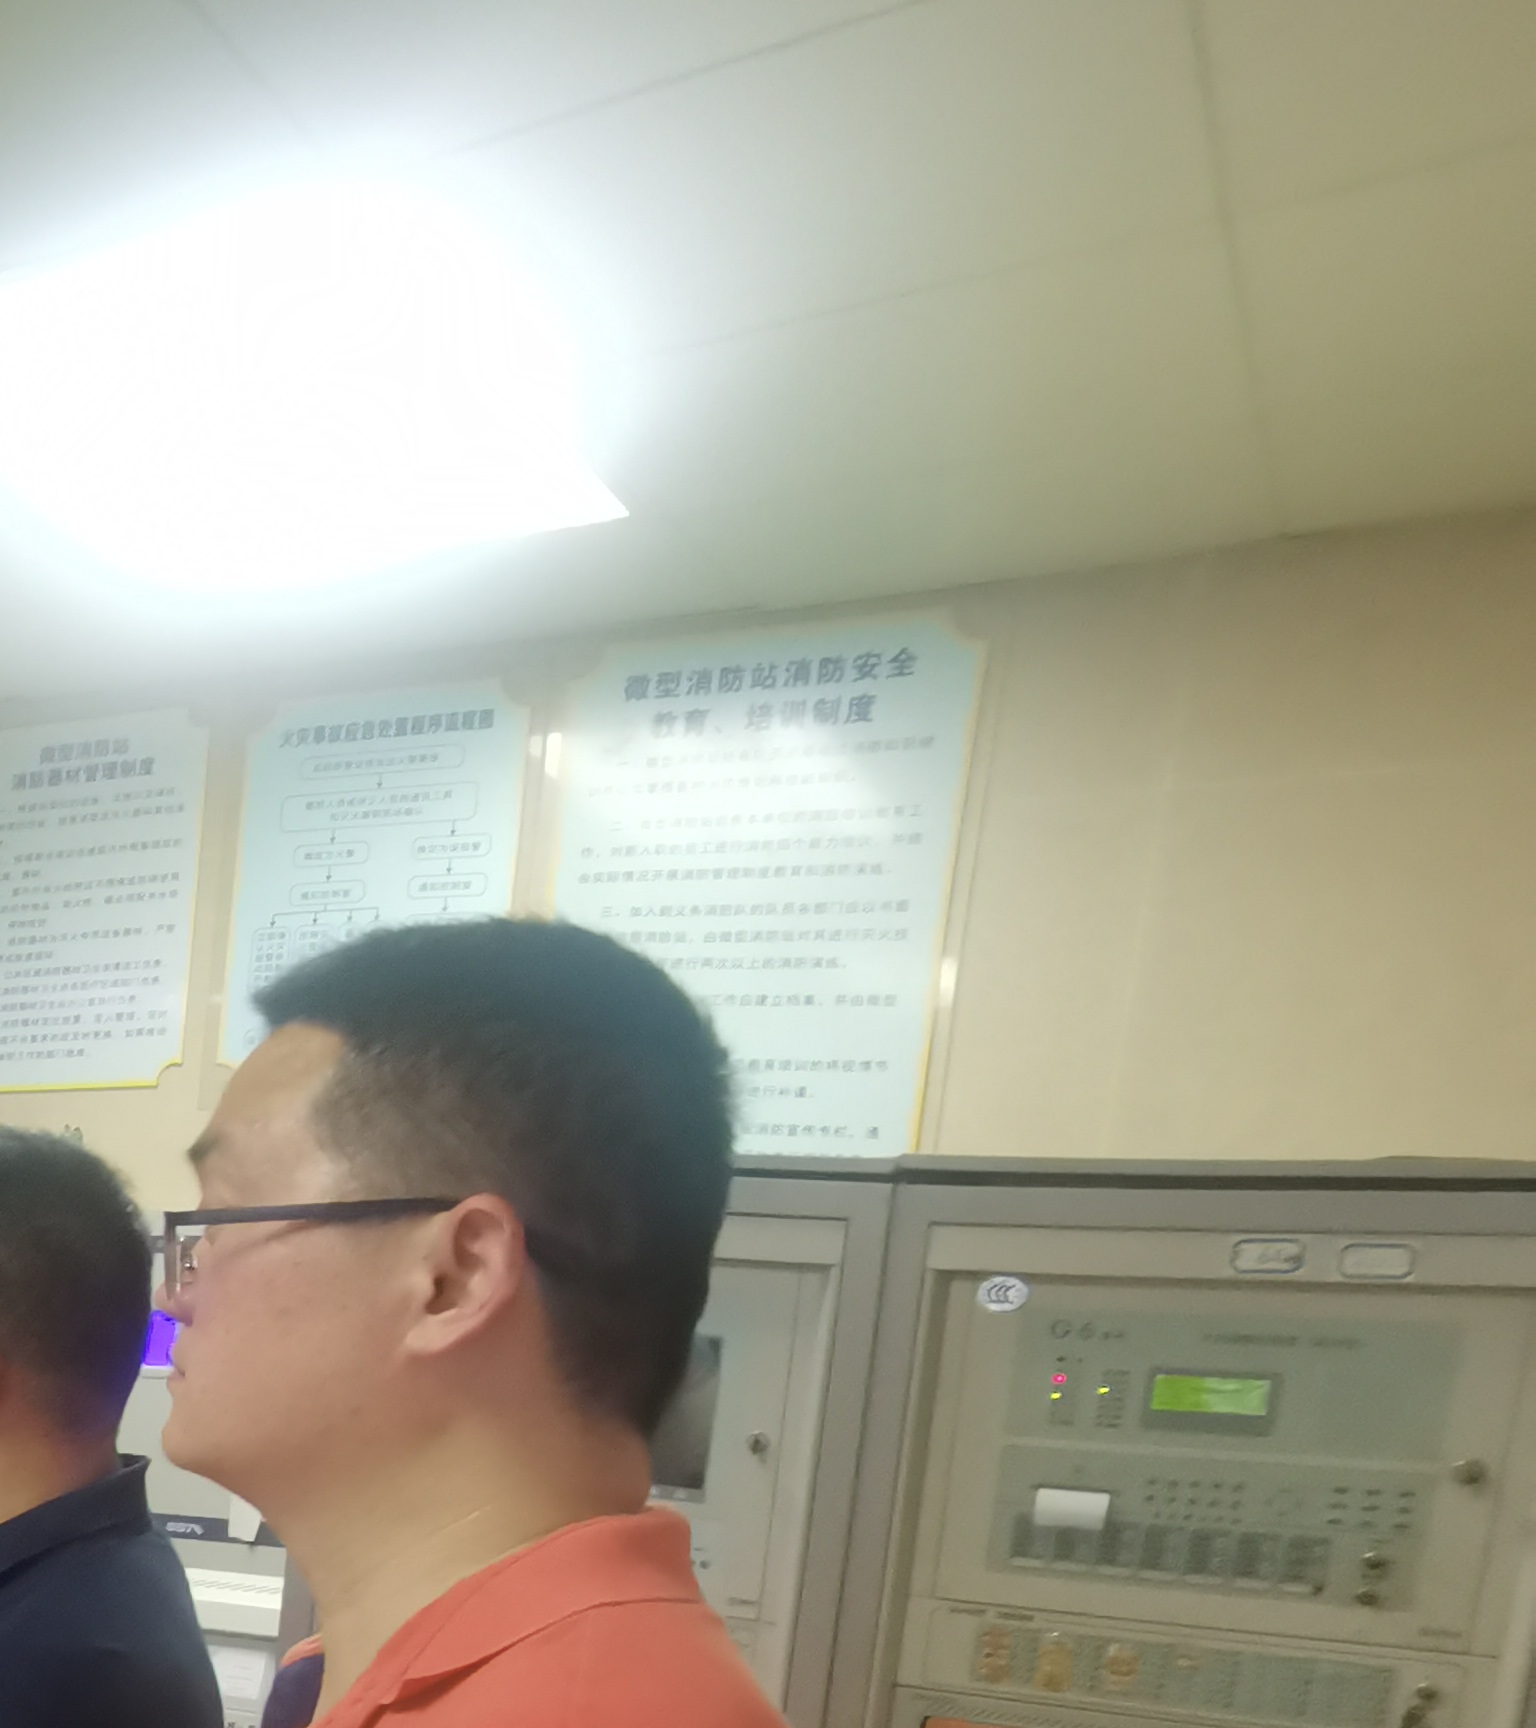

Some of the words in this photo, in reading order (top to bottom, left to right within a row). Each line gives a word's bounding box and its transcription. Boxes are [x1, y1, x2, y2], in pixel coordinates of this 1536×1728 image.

[624, 647, 918, 701] 微型消防站消防安全
